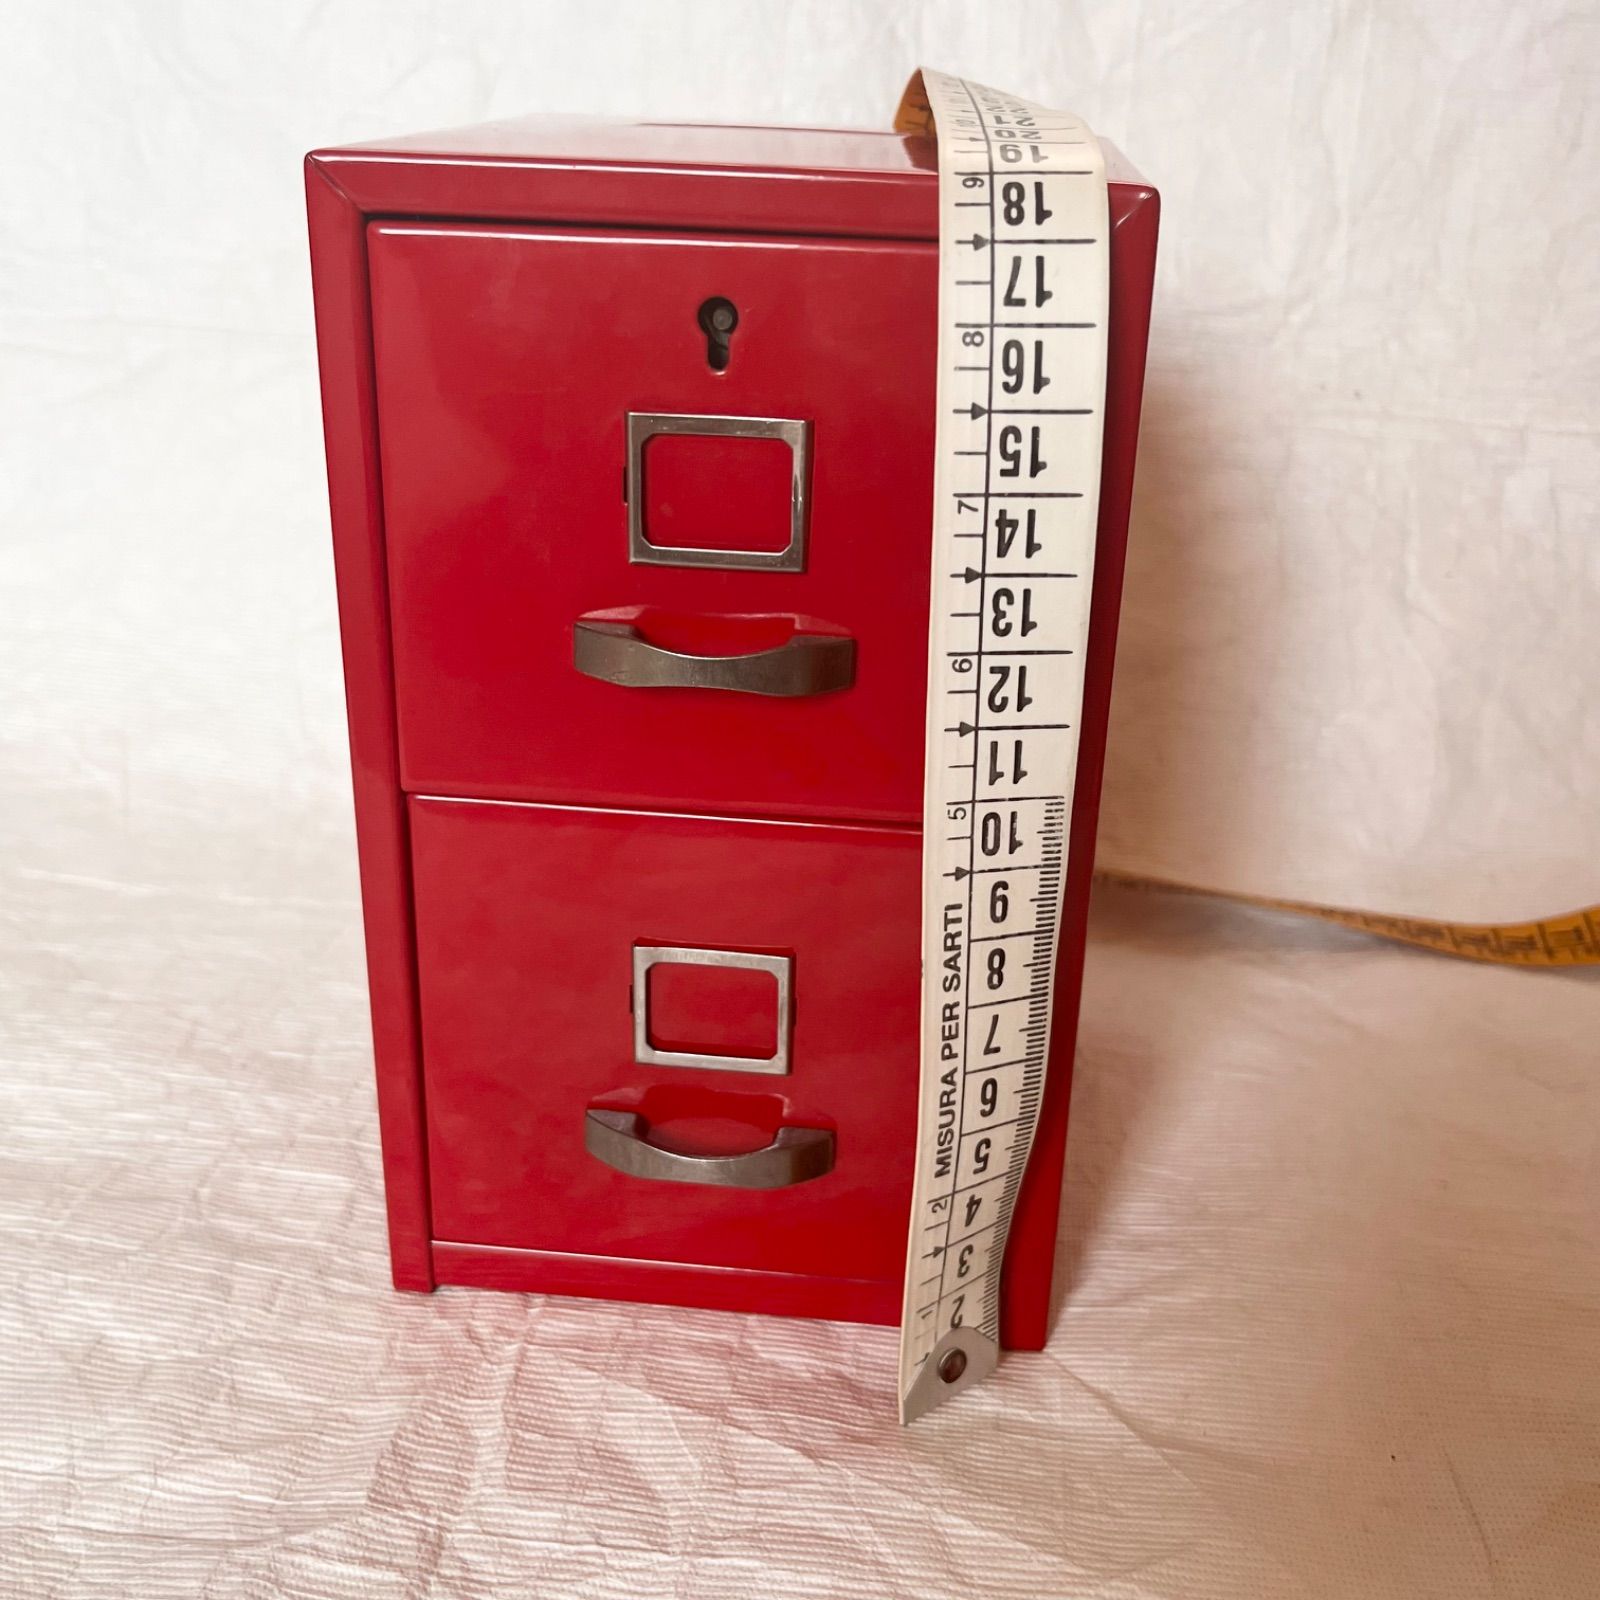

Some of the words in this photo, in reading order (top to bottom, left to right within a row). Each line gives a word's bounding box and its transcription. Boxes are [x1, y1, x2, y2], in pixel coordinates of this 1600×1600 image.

[993, 115, 1036, 127] 21
[994, 129, 1043, 140] 20
[999, 144, 1049, 163] 19
[962, 177, 985, 189] 9
[1002, 182, 1053, 226] 18
[1003, 255, 1053, 308] 17
[962, 331, 985, 347] 8
[1002, 339, 1051, 394] 16
[999, 425, 1048, 478] 15
[957, 499, 979, 515] 7
[995, 508, 1042, 559] 14
[992, 587, 1038, 637] 13
[952, 658, 973, 673] 6
[987, 665, 1033, 713] 12
[988, 739, 1028, 786] 11
[947, 807, 967, 820] 5
[981, 811, 1024, 856] 10
[990, 880, 1009, 924] 9
[942, 902, 964, 993] SARTI
[987, 947, 1006, 990] 8
[941, 1001, 961, 1062] PER
[983, 1013, 1001, 1056] 7
[980, 1077, 998, 1118] 6
[934, 1066, 959, 1179] MISURA
[973, 1137, 991, 1175] 5
[931, 1199, 948, 1214] 2
[965, 1194, 982, 1228] 4
[957, 1244, 974, 1278] 3
[950, 1294, 966, 1329] 2
